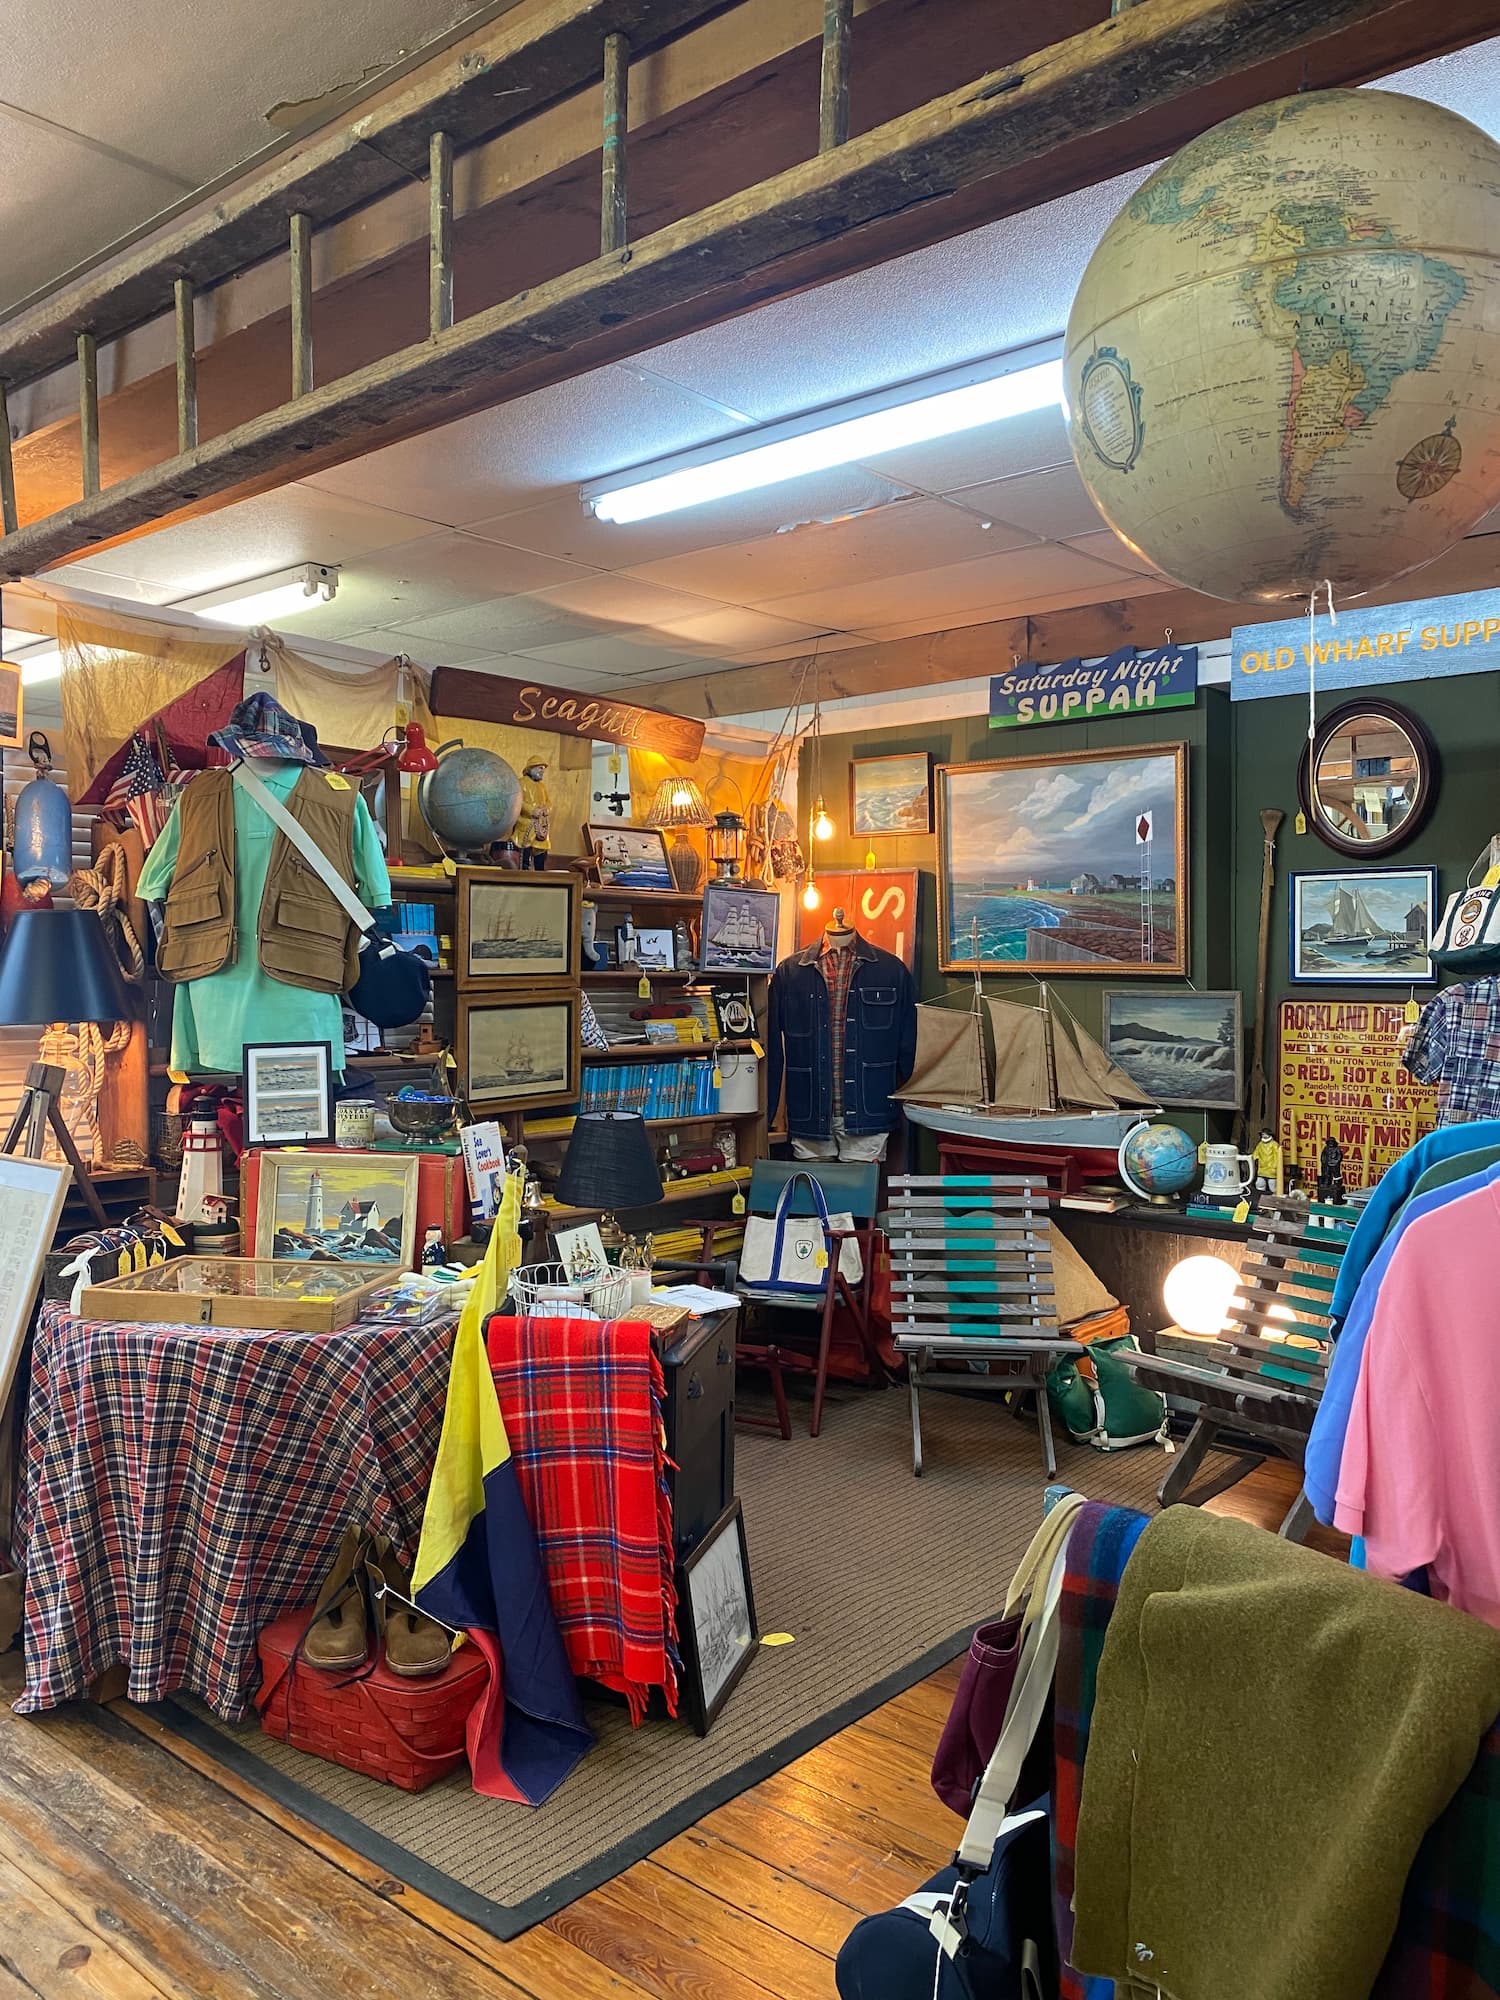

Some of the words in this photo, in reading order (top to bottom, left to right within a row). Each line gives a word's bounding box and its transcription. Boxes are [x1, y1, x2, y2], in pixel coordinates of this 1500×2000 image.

[1292, 312, 1435, 330] AMERICA
[1240, 647, 1295, 674] OLD
[1303, 630, 1412, 666] WHARF
[1420, 617, 1500, 651] SUPP
[999, 668, 1108, 696] Saturday
[1111, 655, 1184, 683] Night
[1016, 680, 1157, 722] SUPPAH
[512, 686, 647, 740] Seagull
[1284, 1005, 1369, 1032] ROCKLAND
[1297, 1032, 1329, 1040] ADULTS
[1284, 1043, 1329, 1053] WEEK
[1334, 1045, 1357, 1054] OF
[1371, 1059, 1396, 1067] Victor
[1298, 1064, 1335, 1081] RED,
[1343, 1066, 1377, 1084] HOT
[1381, 1070, 1391, 1084] &
[1304, 1082, 1339, 1091] Randolph
[1342, 1084, 1370, 1092] SCOTT
[1303, 1113, 1330, 1121] BETTY
[1334, 1115, 1367, 1123] GRABLE
[1382, 1118, 1401, 1126] DAN
[1405, 1120, 1437, 1129] DILEY
[477, 1158, 501, 1173] Cookbook
